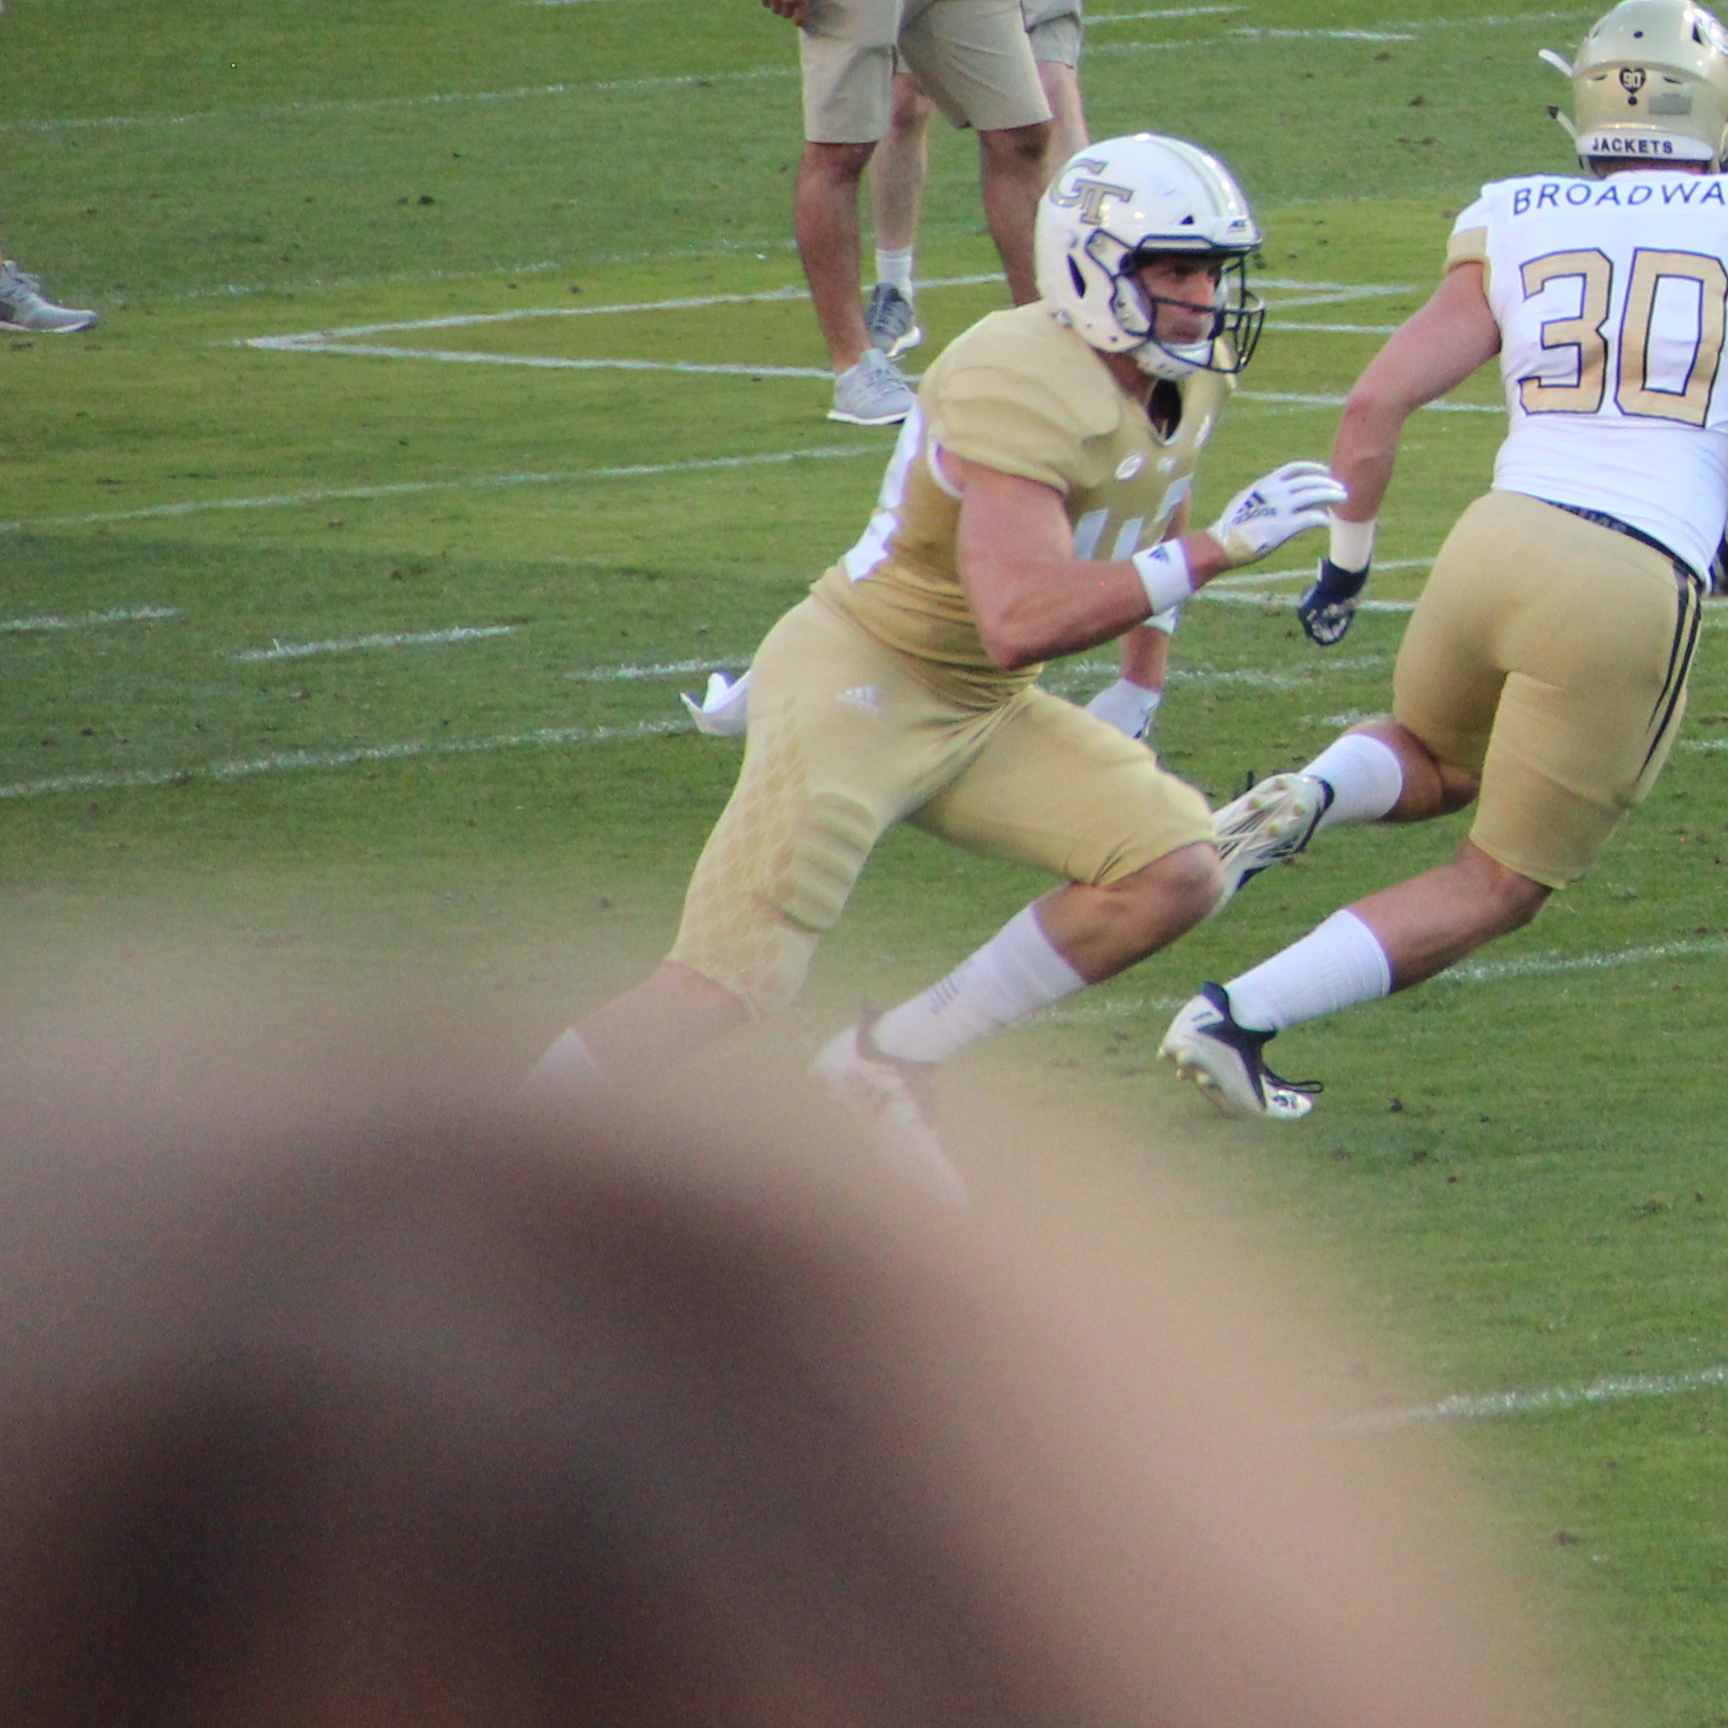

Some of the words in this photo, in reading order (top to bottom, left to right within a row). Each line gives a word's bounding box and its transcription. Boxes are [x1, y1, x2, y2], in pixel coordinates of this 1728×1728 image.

[1621, 73, 1643, 89] 90
[1591, 136, 1675, 156] JACKETS
[1050, 157, 1135, 226] GT
